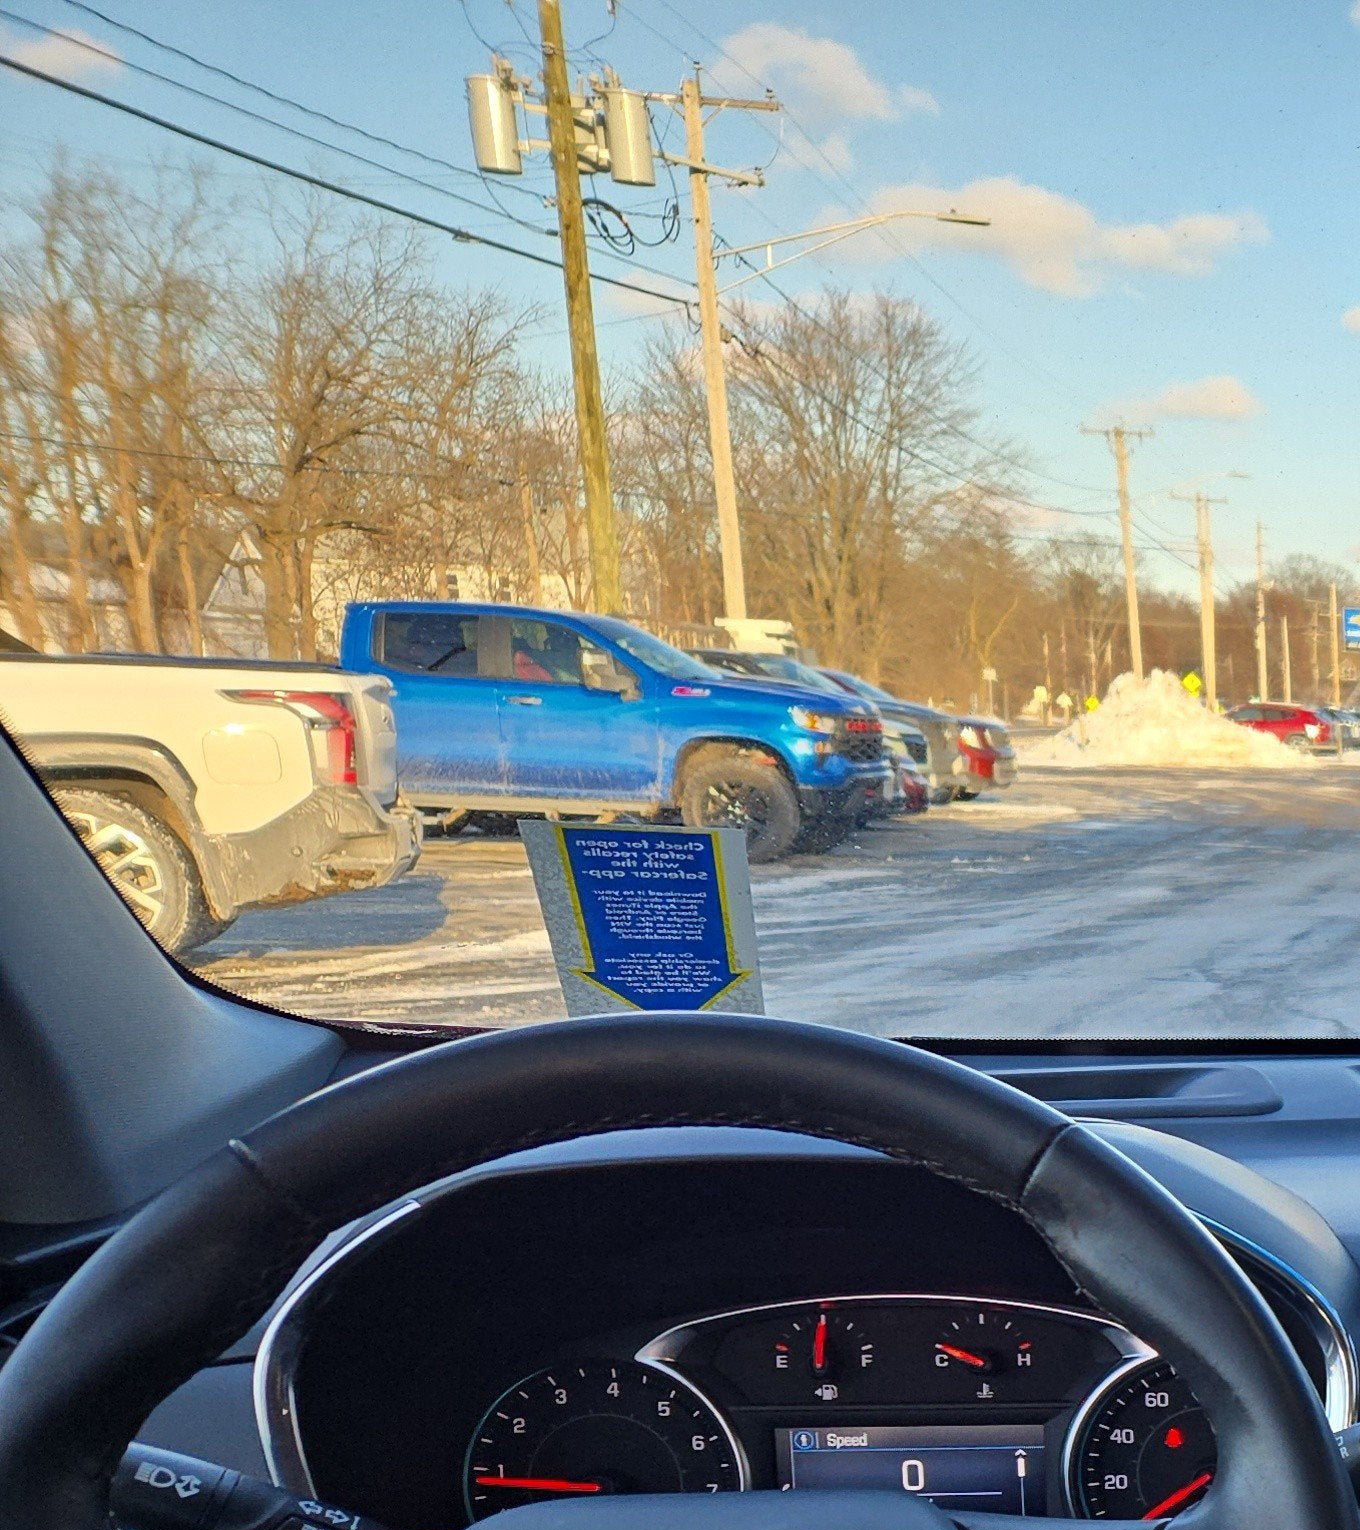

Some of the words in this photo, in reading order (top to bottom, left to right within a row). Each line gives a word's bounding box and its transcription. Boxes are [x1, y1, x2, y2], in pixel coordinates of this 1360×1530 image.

[776, 1355, 788, 1369] E
[861, 1354, 873, 1368] F
[935, 1353, 948, 1368] C
[1018, 1353, 1030, 1367] H
[555, 1389, 567, 1404] 3
[606, 1382, 619, 1398] 4
[1145, 1392, 1169, 1407] 60
[657, 1402, 670, 1417] 5
[513, 1418, 526, 1434] 2
[691, 1435, 705, 1450] 6
[826, 1432, 868, 1449] Speed
[1110, 1428, 1134, 1444] 40
[902, 1460, 924, 1491] 0
[1104, 1474, 1128, 1490] 20
